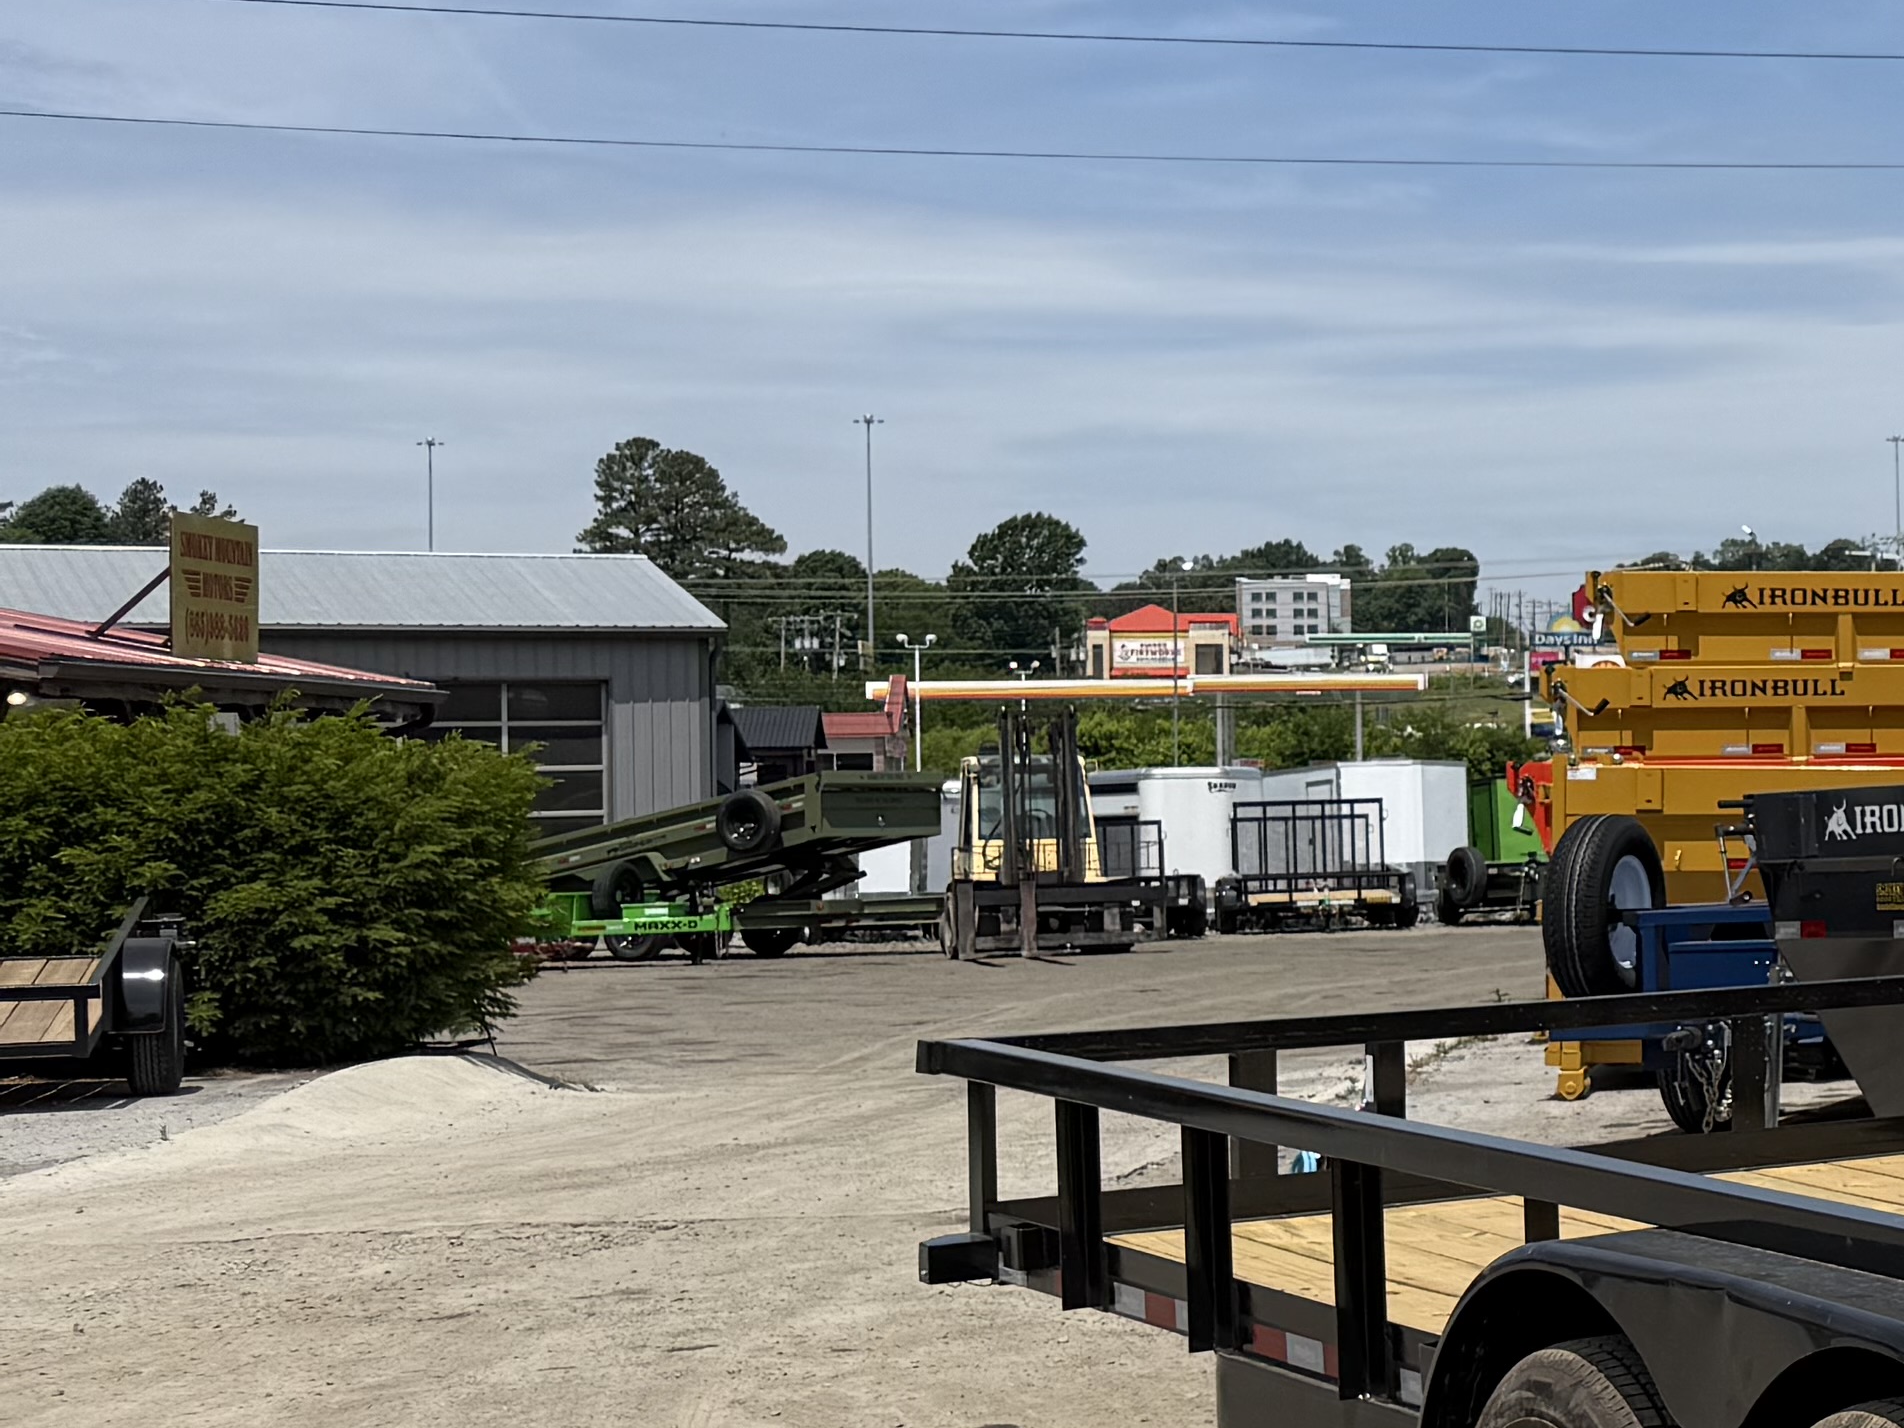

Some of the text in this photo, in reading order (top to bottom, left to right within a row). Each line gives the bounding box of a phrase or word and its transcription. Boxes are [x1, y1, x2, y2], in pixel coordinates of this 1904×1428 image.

[1534, 633, 1570, 646] Days
[1697, 678, 1846, 697] IRONBULL
[634, 920, 698, 932] MAXX-D
